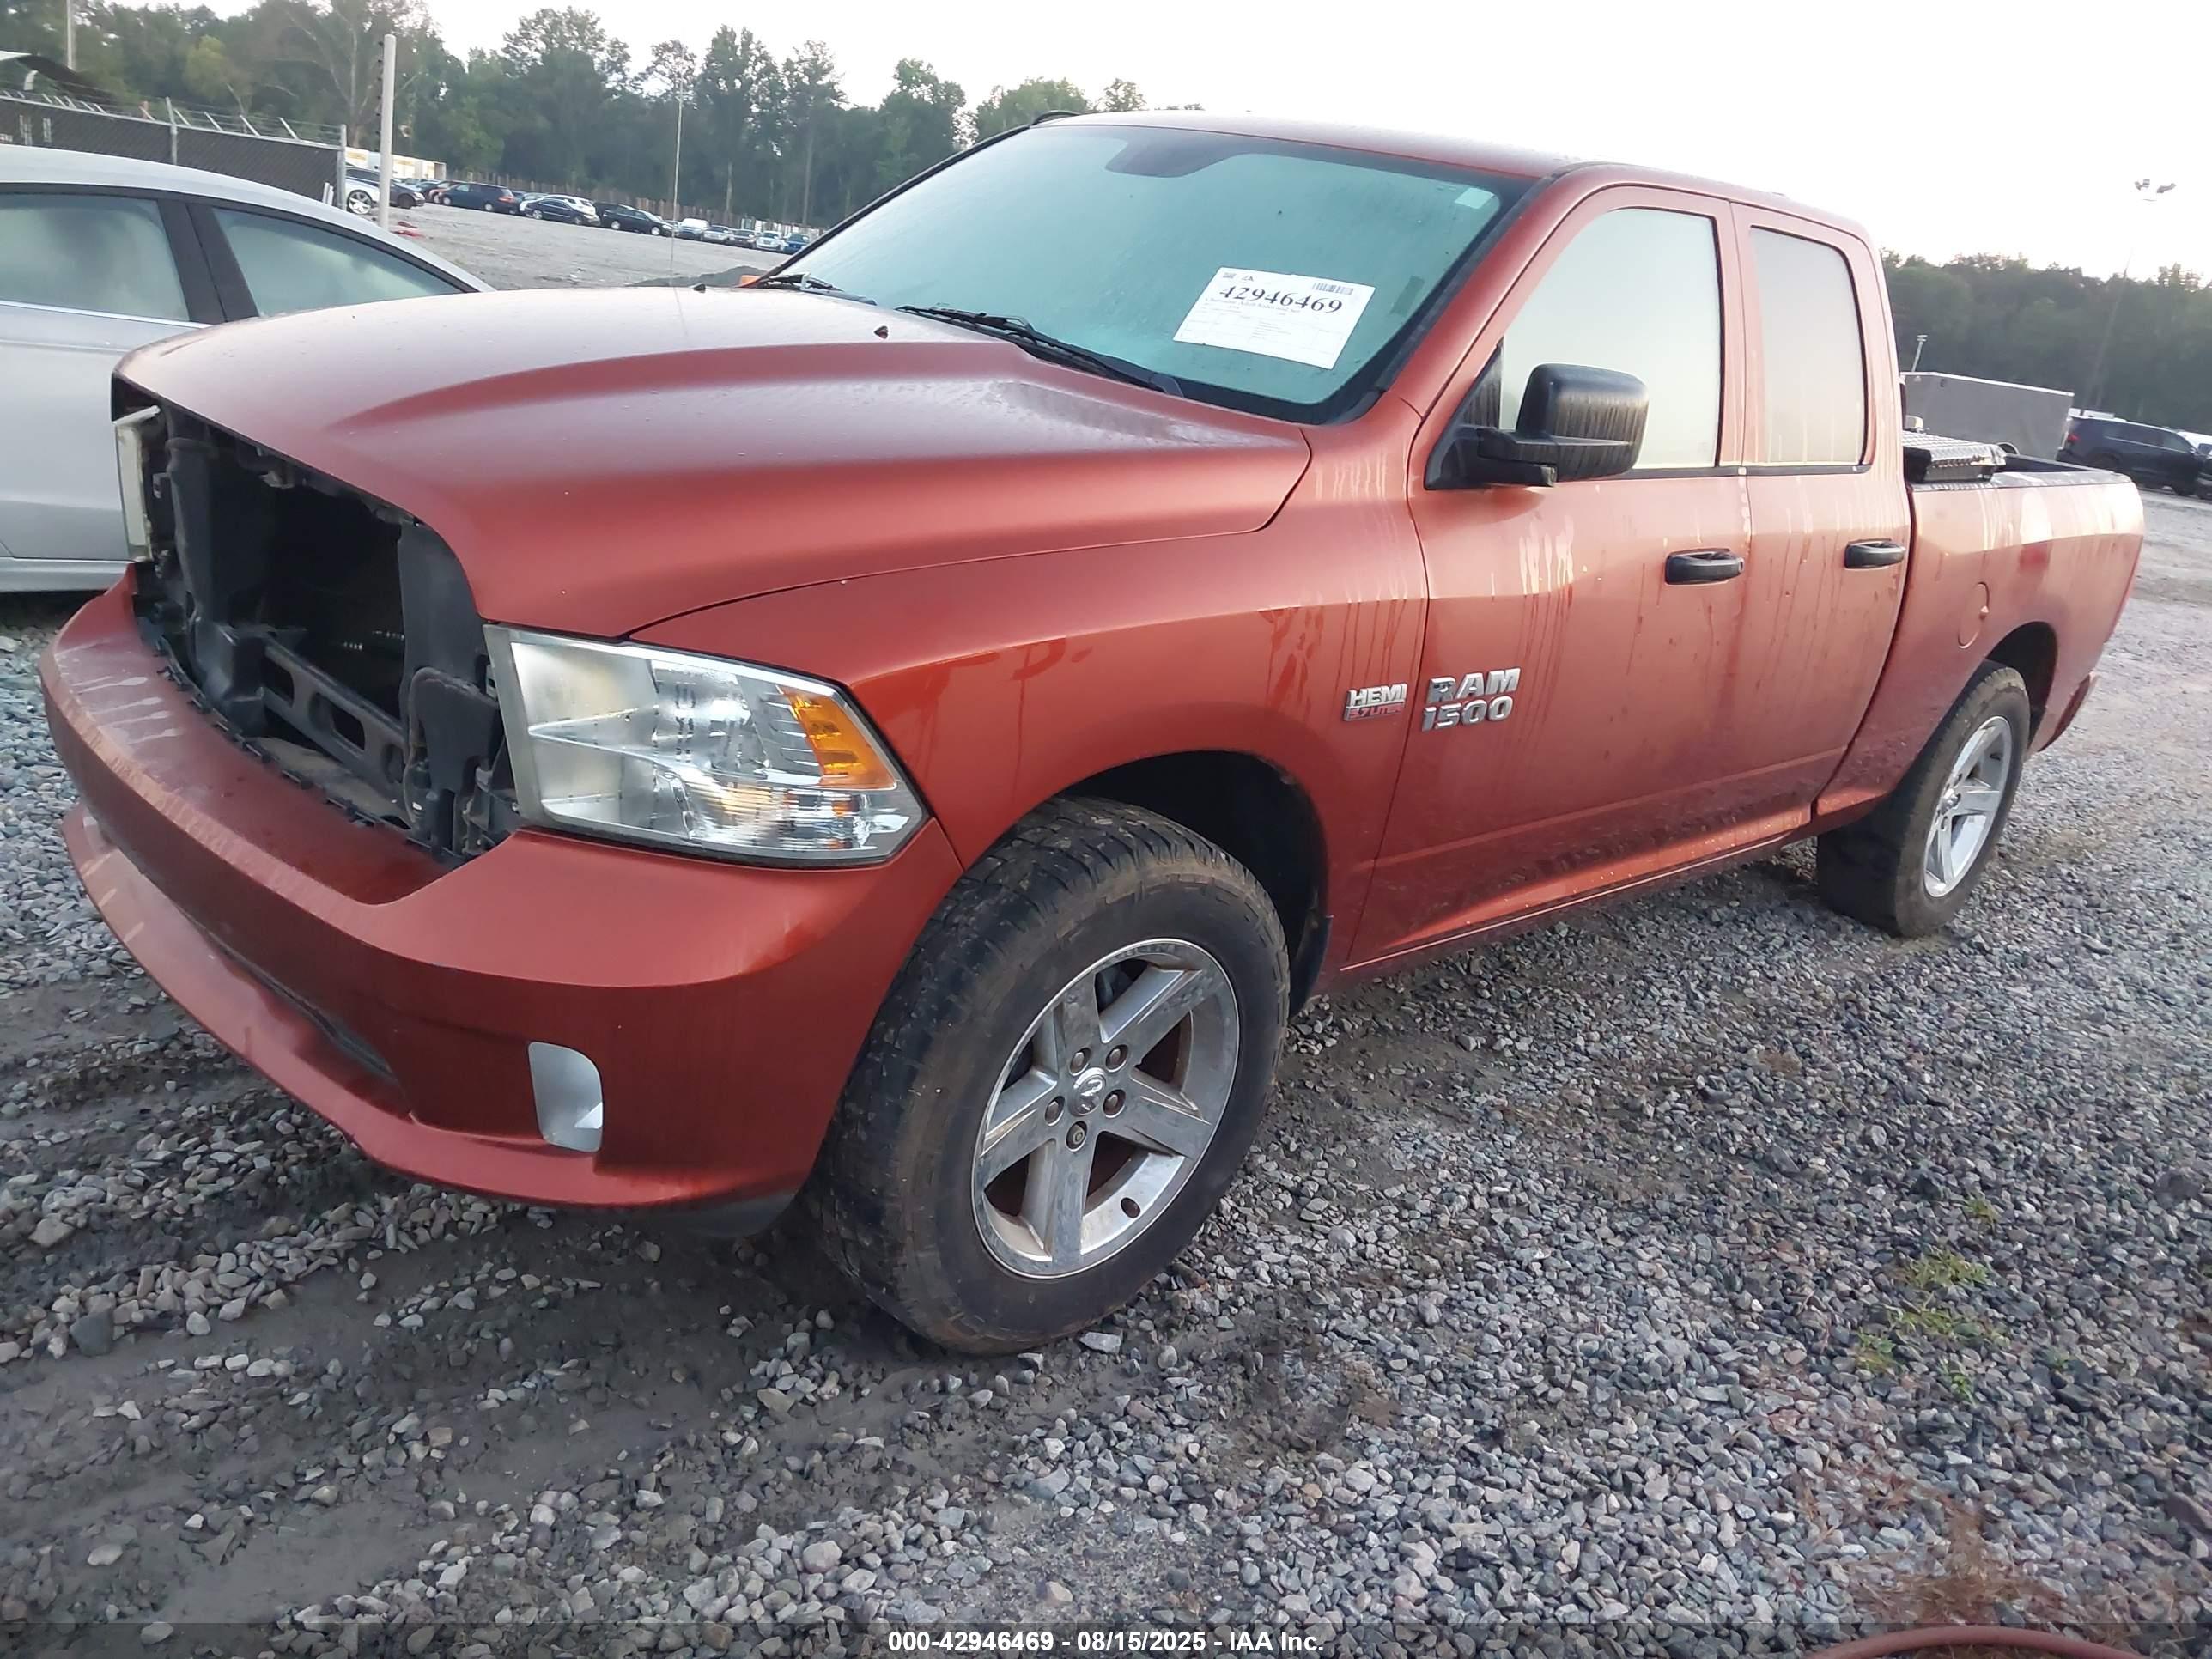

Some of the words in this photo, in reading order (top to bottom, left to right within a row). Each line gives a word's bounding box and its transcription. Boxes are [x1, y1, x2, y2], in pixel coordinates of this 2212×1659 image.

[1219, 285, 1343, 313] 42946469
[1346, 683, 1408, 708] HEMI
[1426, 667, 1521, 704] RAM
[1422, 696, 1514, 732] 1500
